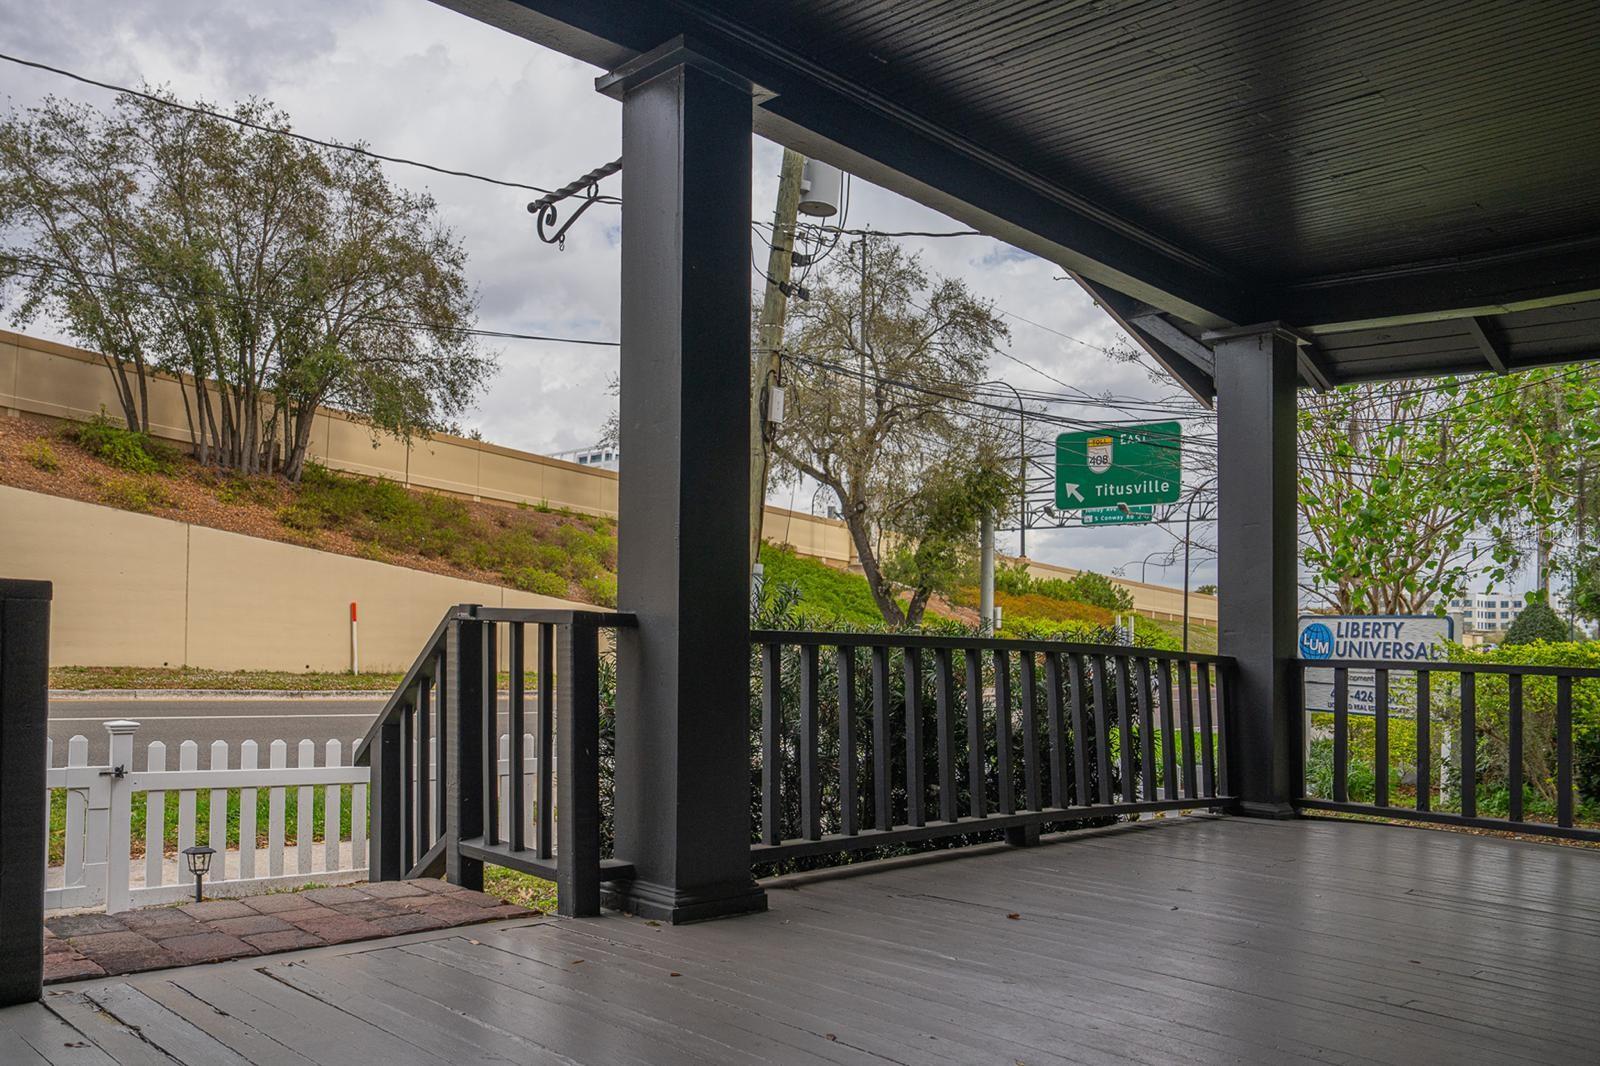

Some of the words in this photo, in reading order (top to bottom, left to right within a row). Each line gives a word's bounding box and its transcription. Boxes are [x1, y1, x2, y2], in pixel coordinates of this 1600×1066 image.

[1089, 455, 1109, 466] 408
[1095, 480, 1170, 497] Titusville
[1336, 621, 1405, 639] LIBERTY
[1304, 633, 1330, 655] LUM
